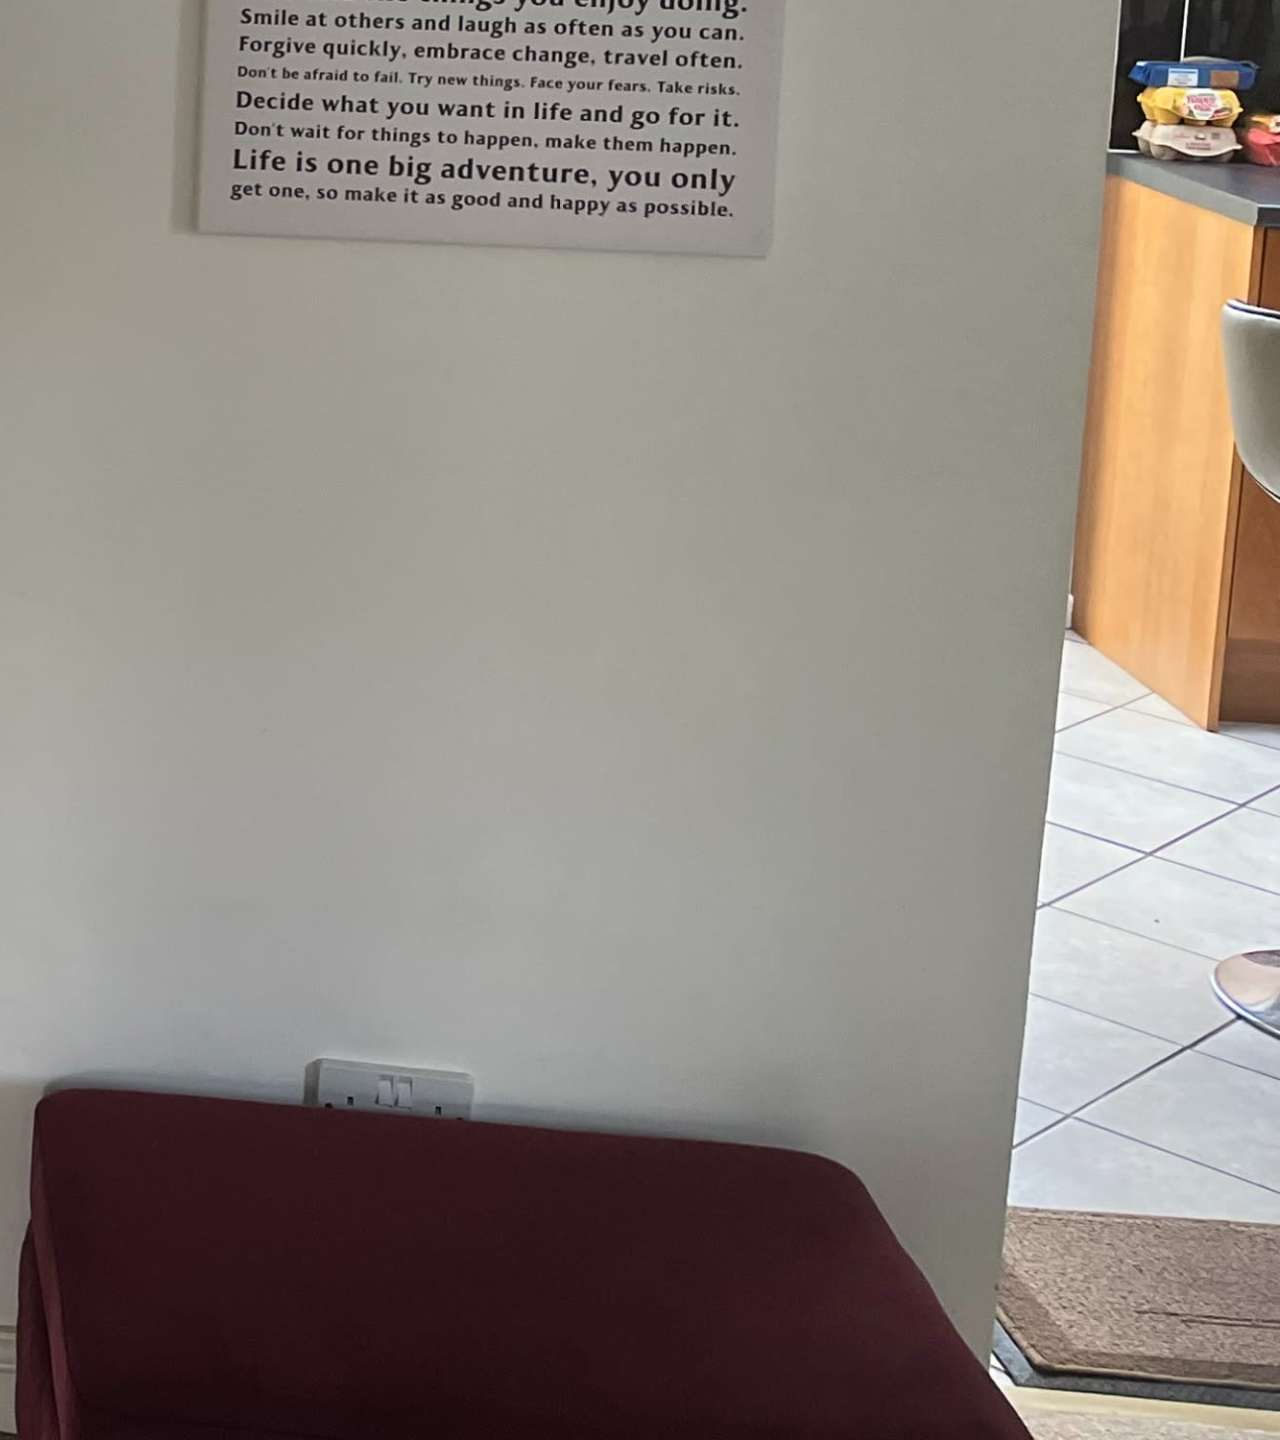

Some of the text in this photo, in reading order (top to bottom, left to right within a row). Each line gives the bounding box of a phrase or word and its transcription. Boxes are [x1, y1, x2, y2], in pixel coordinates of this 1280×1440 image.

[238, 34, 743, 70] Forgive quickly, embrace change, travel often.
[235, 89, 740, 131] Decide what you want in life and go for it.
[232, 147, 737, 198] Life is one big adventure, you only
[229, 182, 734, 220] get one, so make it as good and happy as possible.
